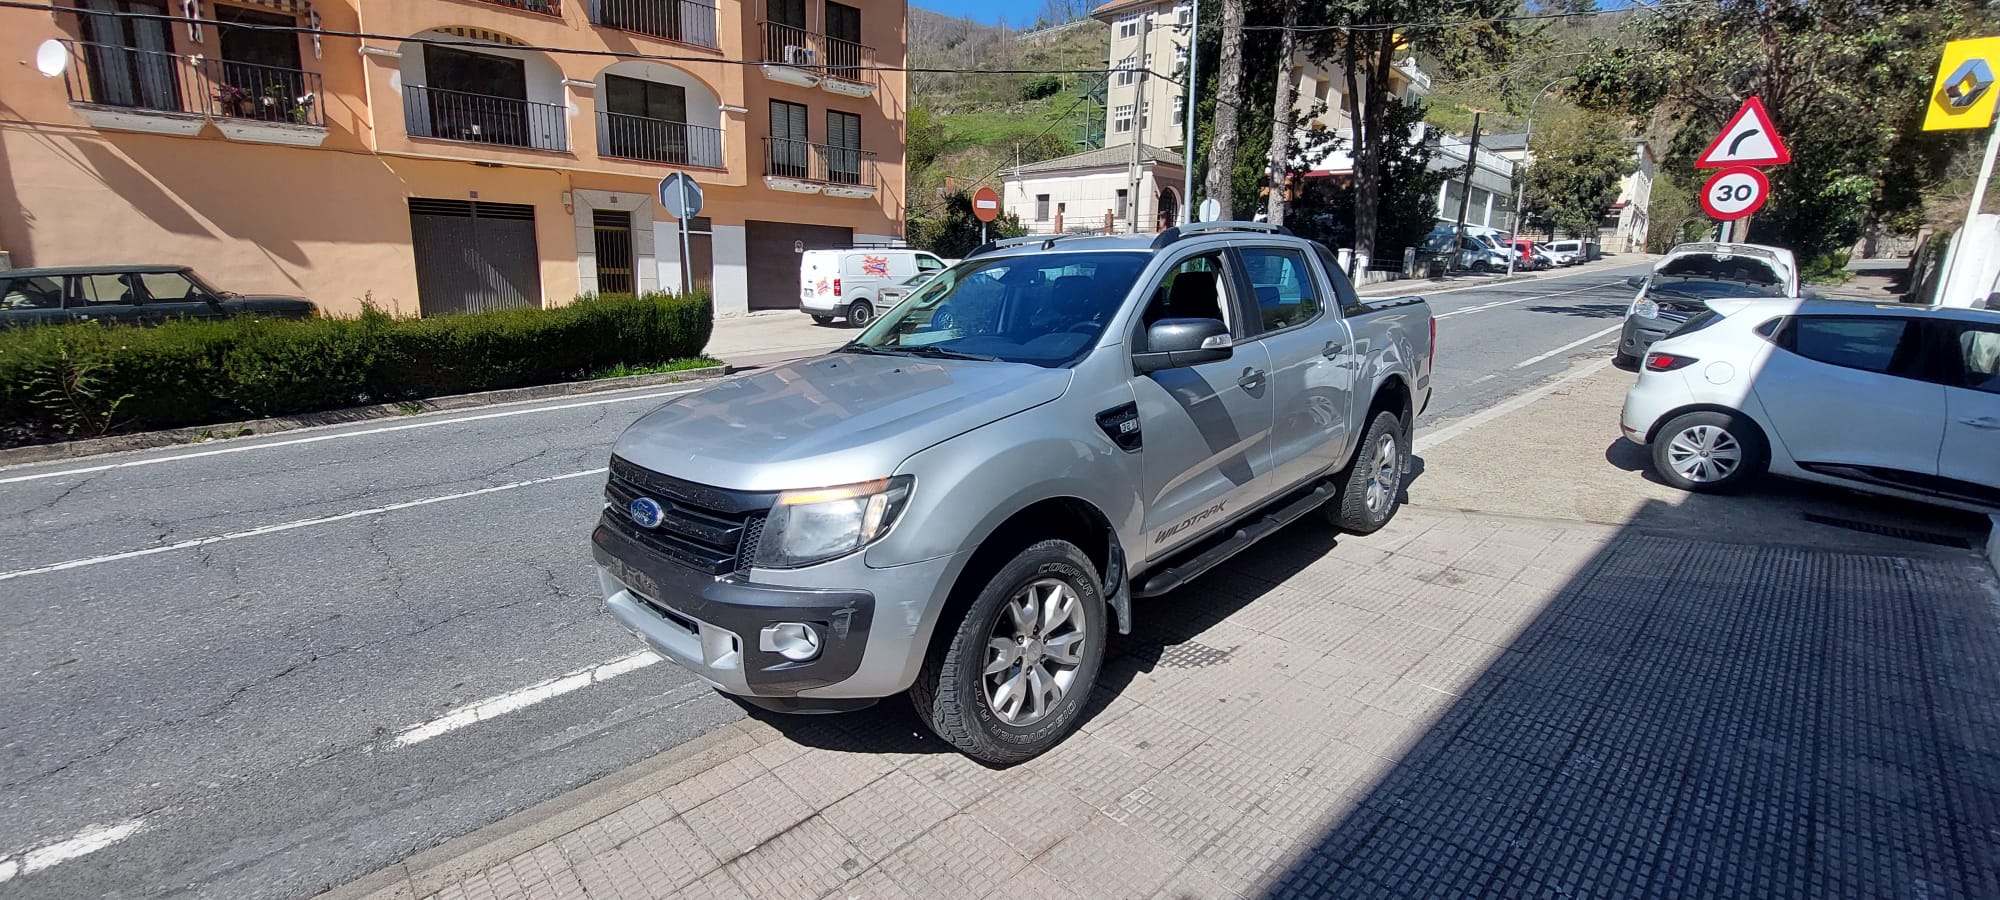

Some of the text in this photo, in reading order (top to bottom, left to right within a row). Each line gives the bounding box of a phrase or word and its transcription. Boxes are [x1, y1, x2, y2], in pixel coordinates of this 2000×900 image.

[1716, 184, 1752, 202] 30
[1154, 499, 1227, 544] WILDTRAK
[1038, 562, 1094, 597] COOPER
[991, 700, 1077, 745] DISCOVERER
